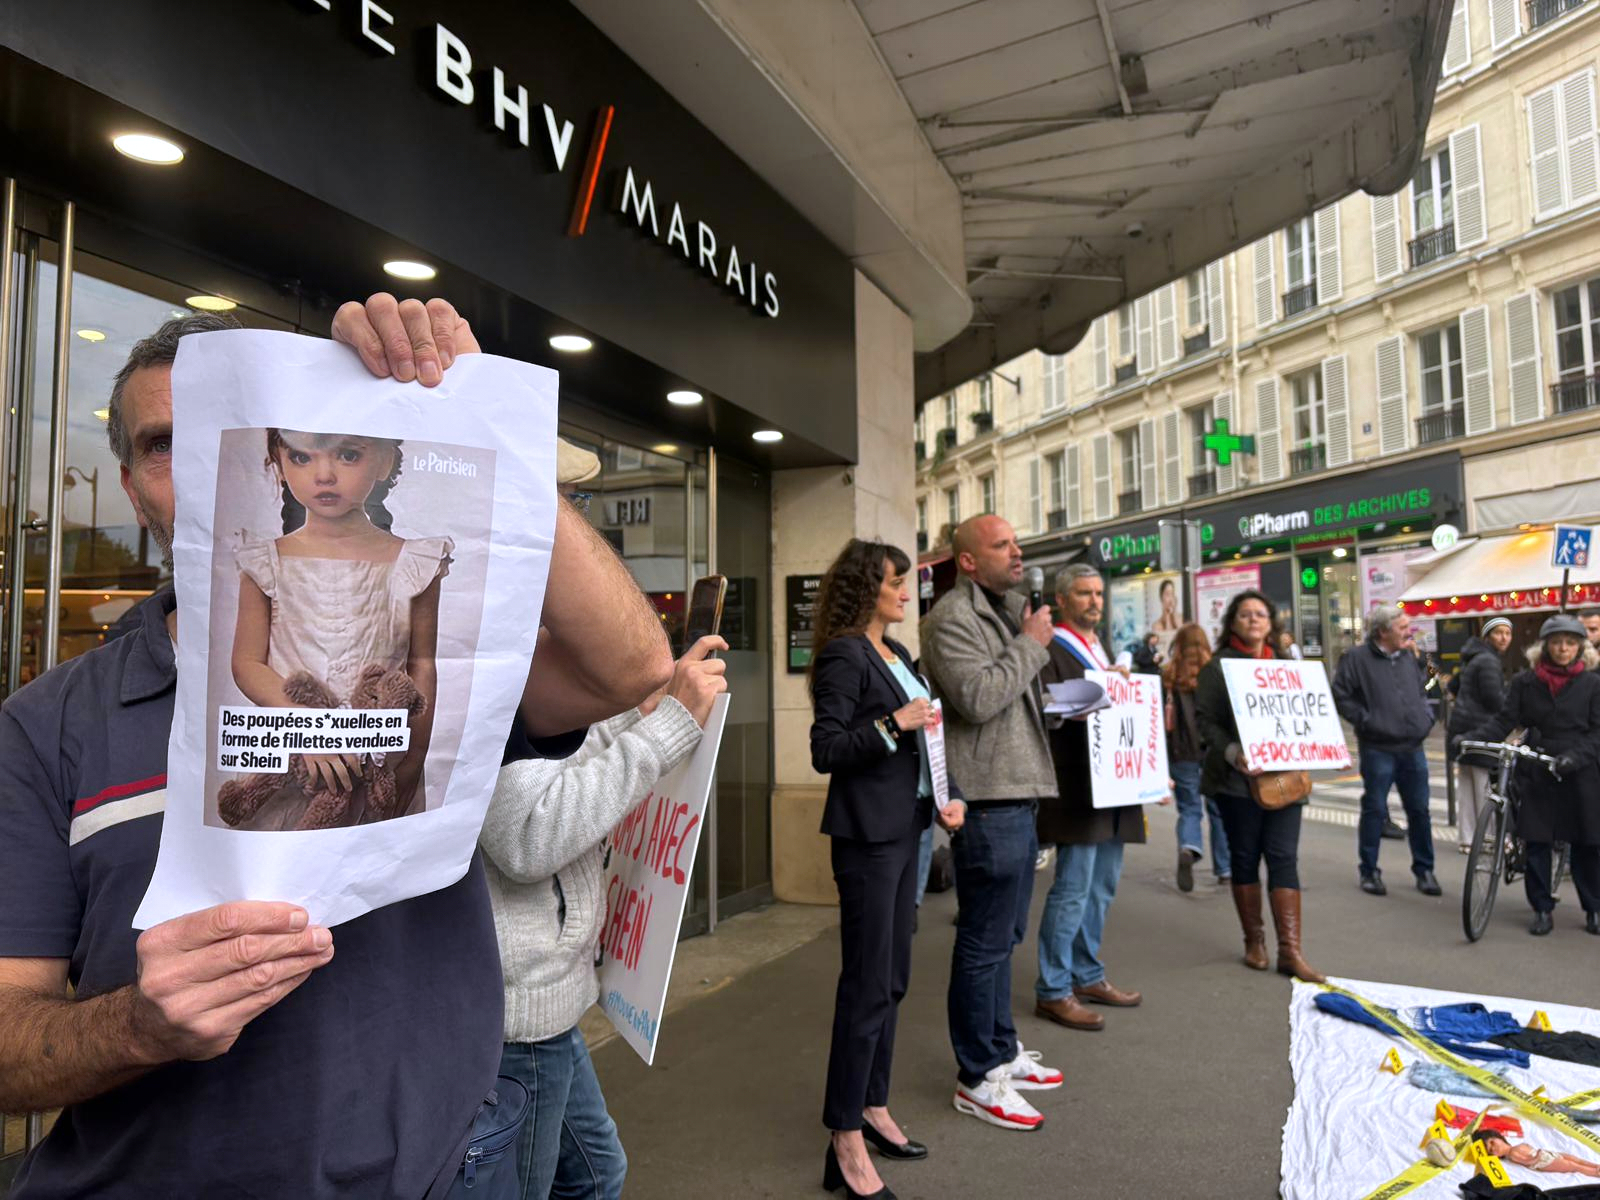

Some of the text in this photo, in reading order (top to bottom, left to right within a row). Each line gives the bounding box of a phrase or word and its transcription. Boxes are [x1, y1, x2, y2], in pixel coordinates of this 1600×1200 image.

[437, 22, 575, 172] BHV
[620, 165, 780, 318] MARAIS
[413, 451, 477, 478] Le Parisien
[1314, 503, 1344, 527] DES
[1346, 487, 1431, 520] ARCHIVES
[1107, 676, 1143, 705] HONTE
[1245, 692, 1328, 717] PARTICIPE
[223, 710, 245, 727] Des
[247, 713, 316, 730] poupées
[385, 716, 402, 728] en
[1119, 717, 1135, 747] AU
[1294, 720, 1311, 736] LA
[222, 730, 403, 749] forme de fillettes vendues
[221, 752, 282, 768] sur Shein
[1115, 748, 1143, 779] BHV
[644, 796, 699, 885] AVEC
[1488, 1160, 1503, 1181] 6
